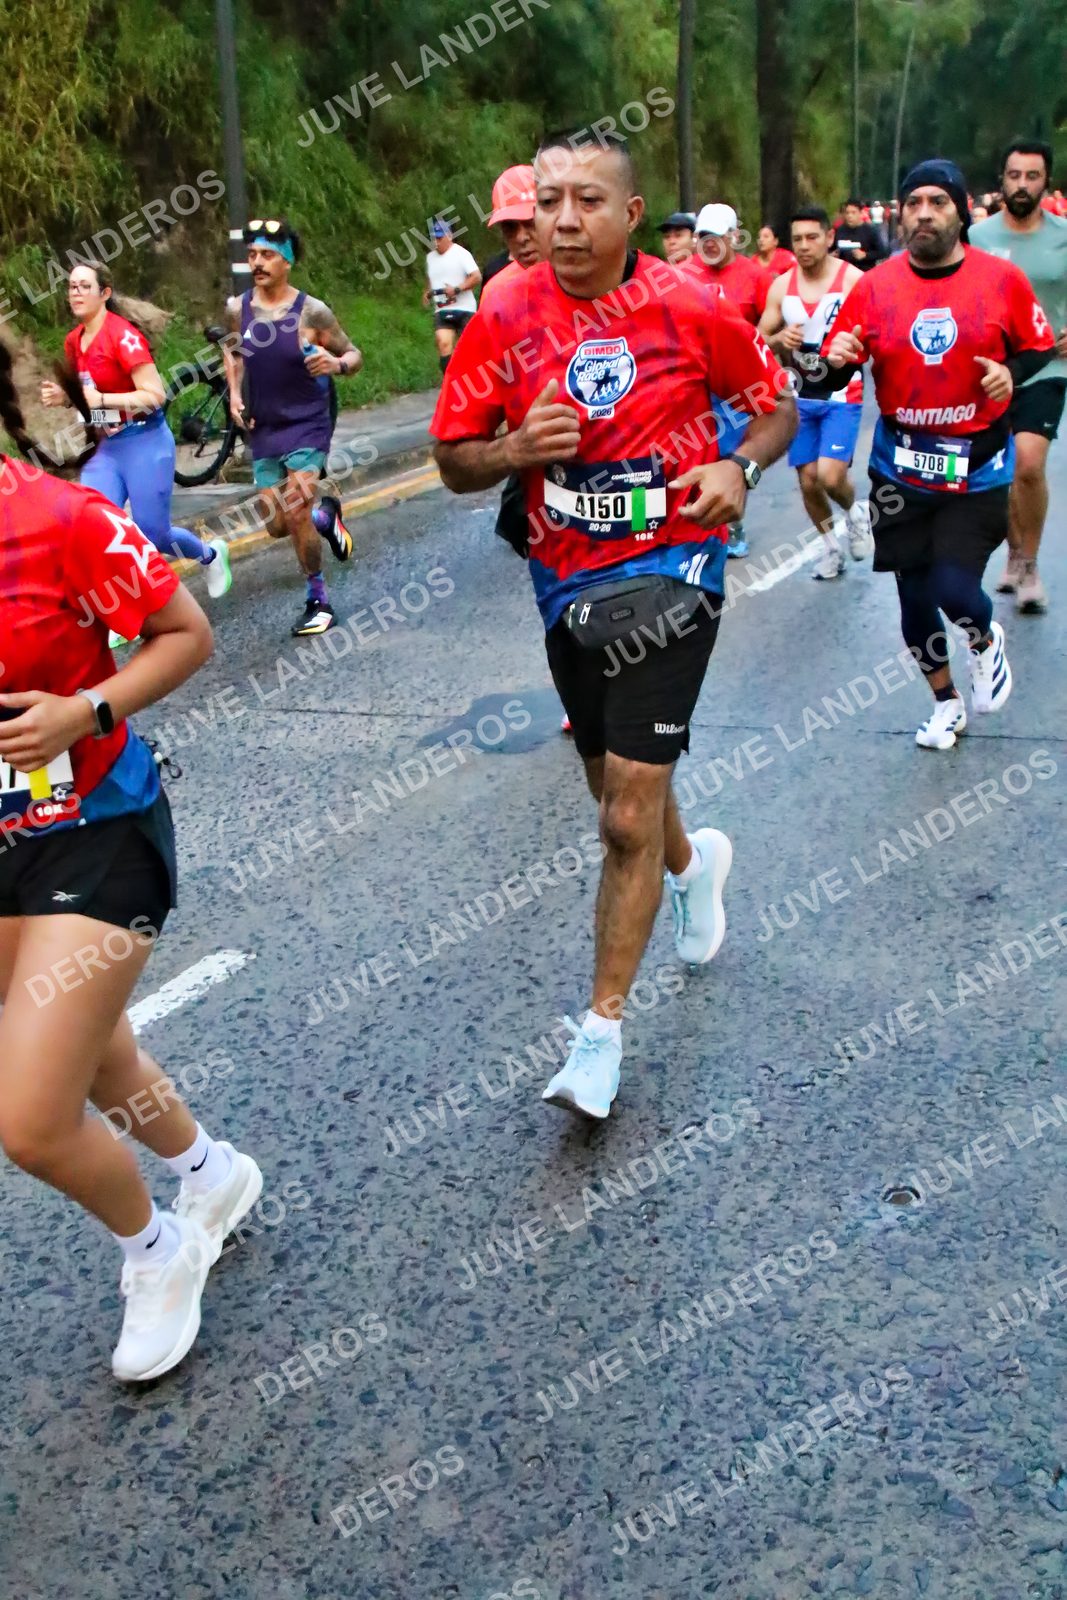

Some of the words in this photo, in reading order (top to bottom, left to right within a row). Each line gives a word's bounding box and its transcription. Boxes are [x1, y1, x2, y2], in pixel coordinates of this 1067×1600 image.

[584, 358, 620, 373] Global
[578, 369, 606, 381] Race
[591, 408, 612, 418] 2026
[896, 403, 976, 425] SANTIAGO
[914, 453, 944, 472] 5708
[575, 495, 625, 518] 4150
